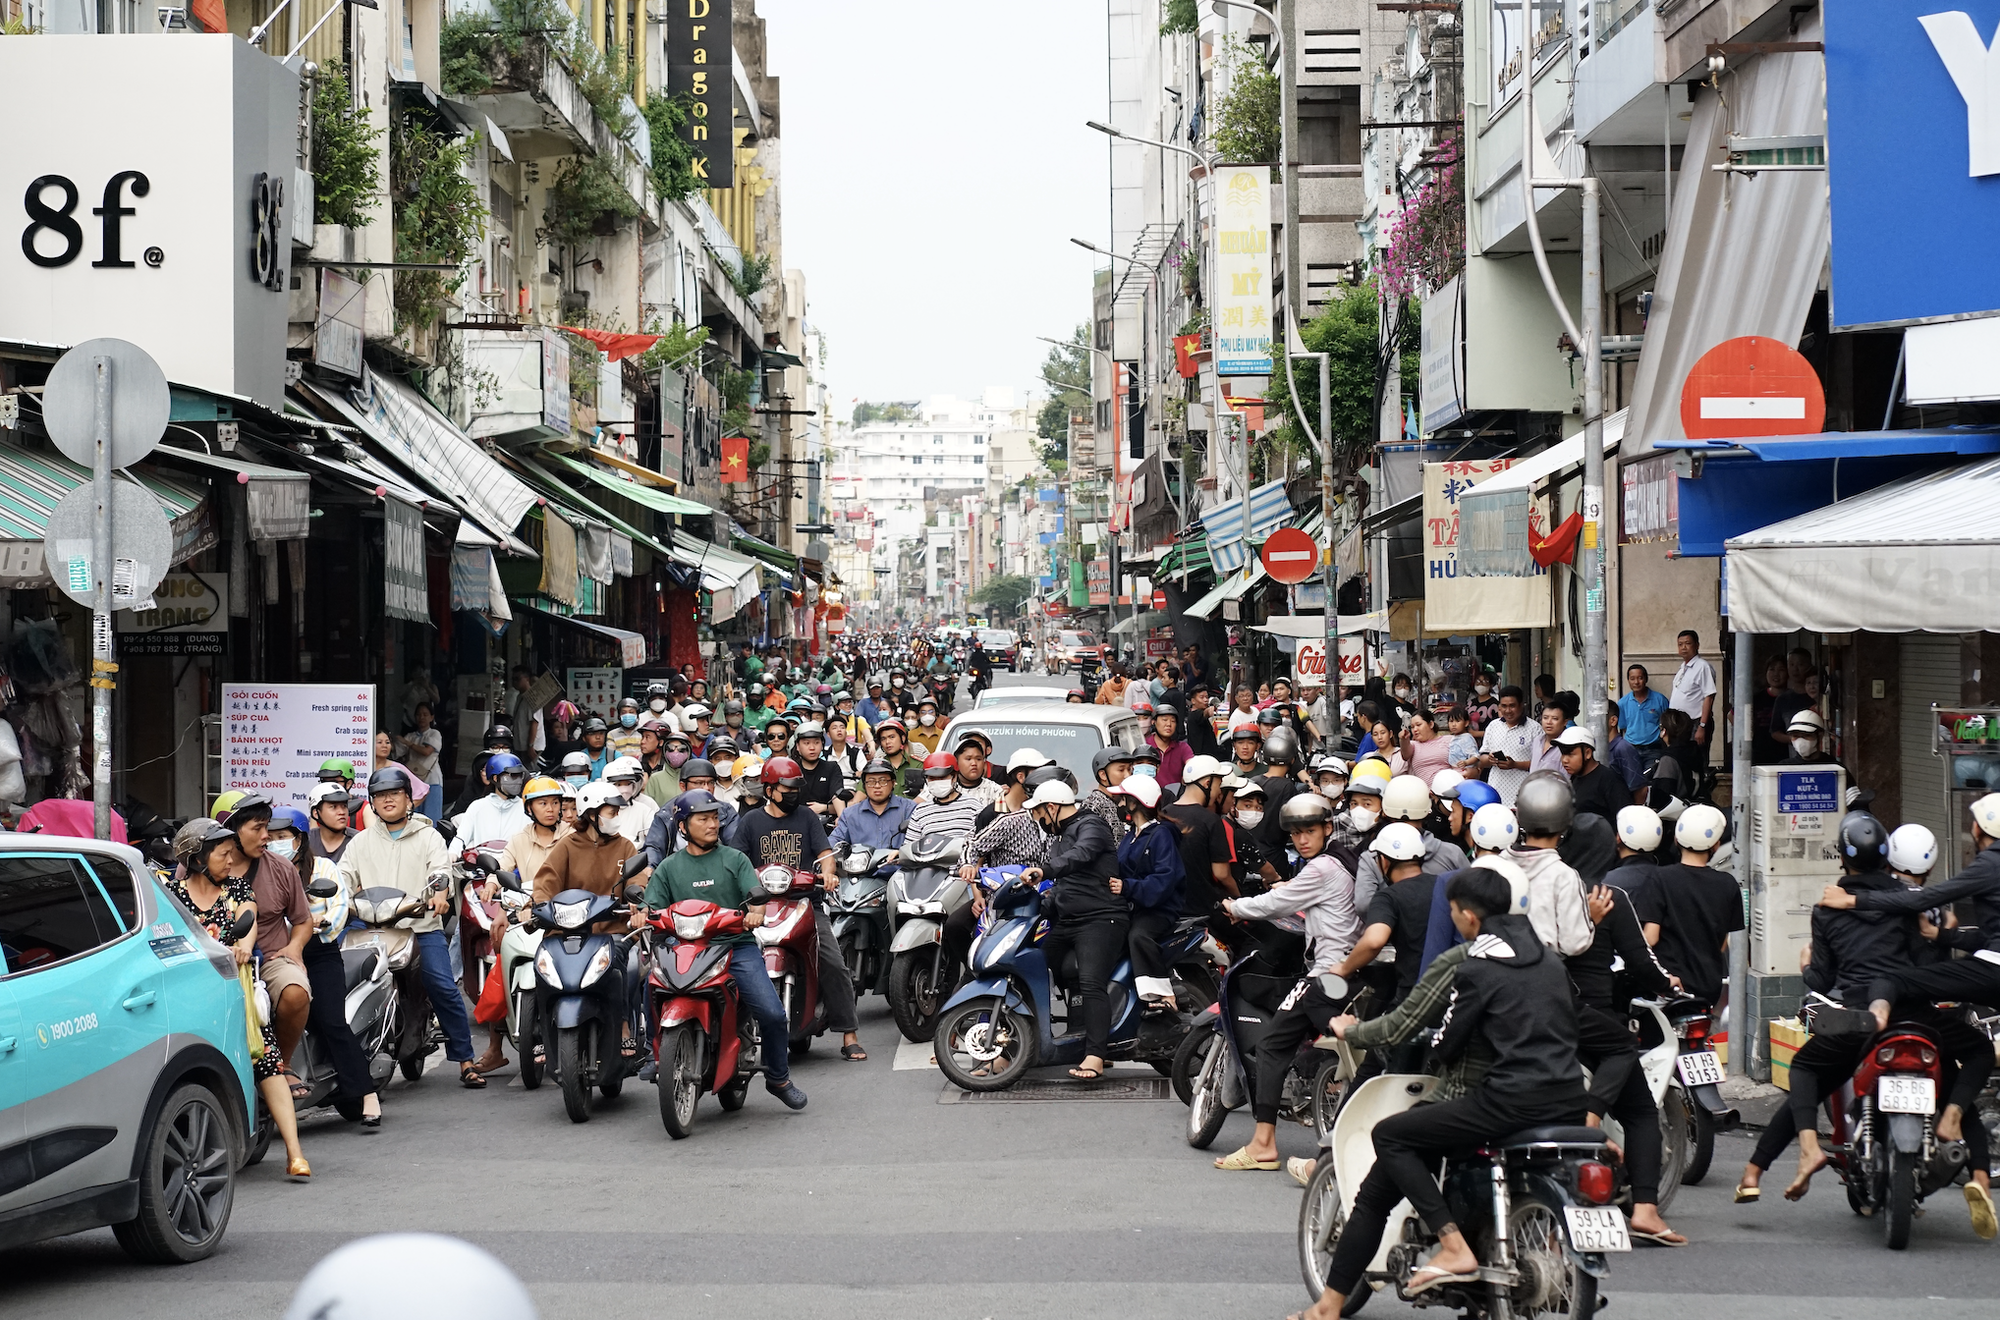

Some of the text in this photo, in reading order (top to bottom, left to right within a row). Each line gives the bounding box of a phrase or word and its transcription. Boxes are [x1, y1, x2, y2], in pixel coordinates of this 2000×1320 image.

[692, 157, 709, 179] K
[1222, 304, 1268, 328] 潤美
[156, 578, 206, 598] UNG
[136, 607, 211, 626] TRANG
[184, 645, 222, 653] (TRANG)
[312, 704, 368, 713] Fresh spring rolls
[259, 737, 283, 745] KHỌT
[231, 758, 270, 766] BÚN RIÊU
[296, 749, 368, 758] Mini savory pancakes
[285, 770, 300, 778] Crab
[760, 834, 803, 855] GAME
[50, 1012, 99, 1040] 1900 2088
[1682, 1053, 1714, 1069] 61 H3
[1687, 1067, 1720, 1084] 9153
[1888, 1079, 1925, 1095] 36-B6
[1883, 1095, 1930, 1112] 583.97
[1574, 1210, 1617, 1228] 59-LA
[1575, 1230, 1624, 1249] 062.47
